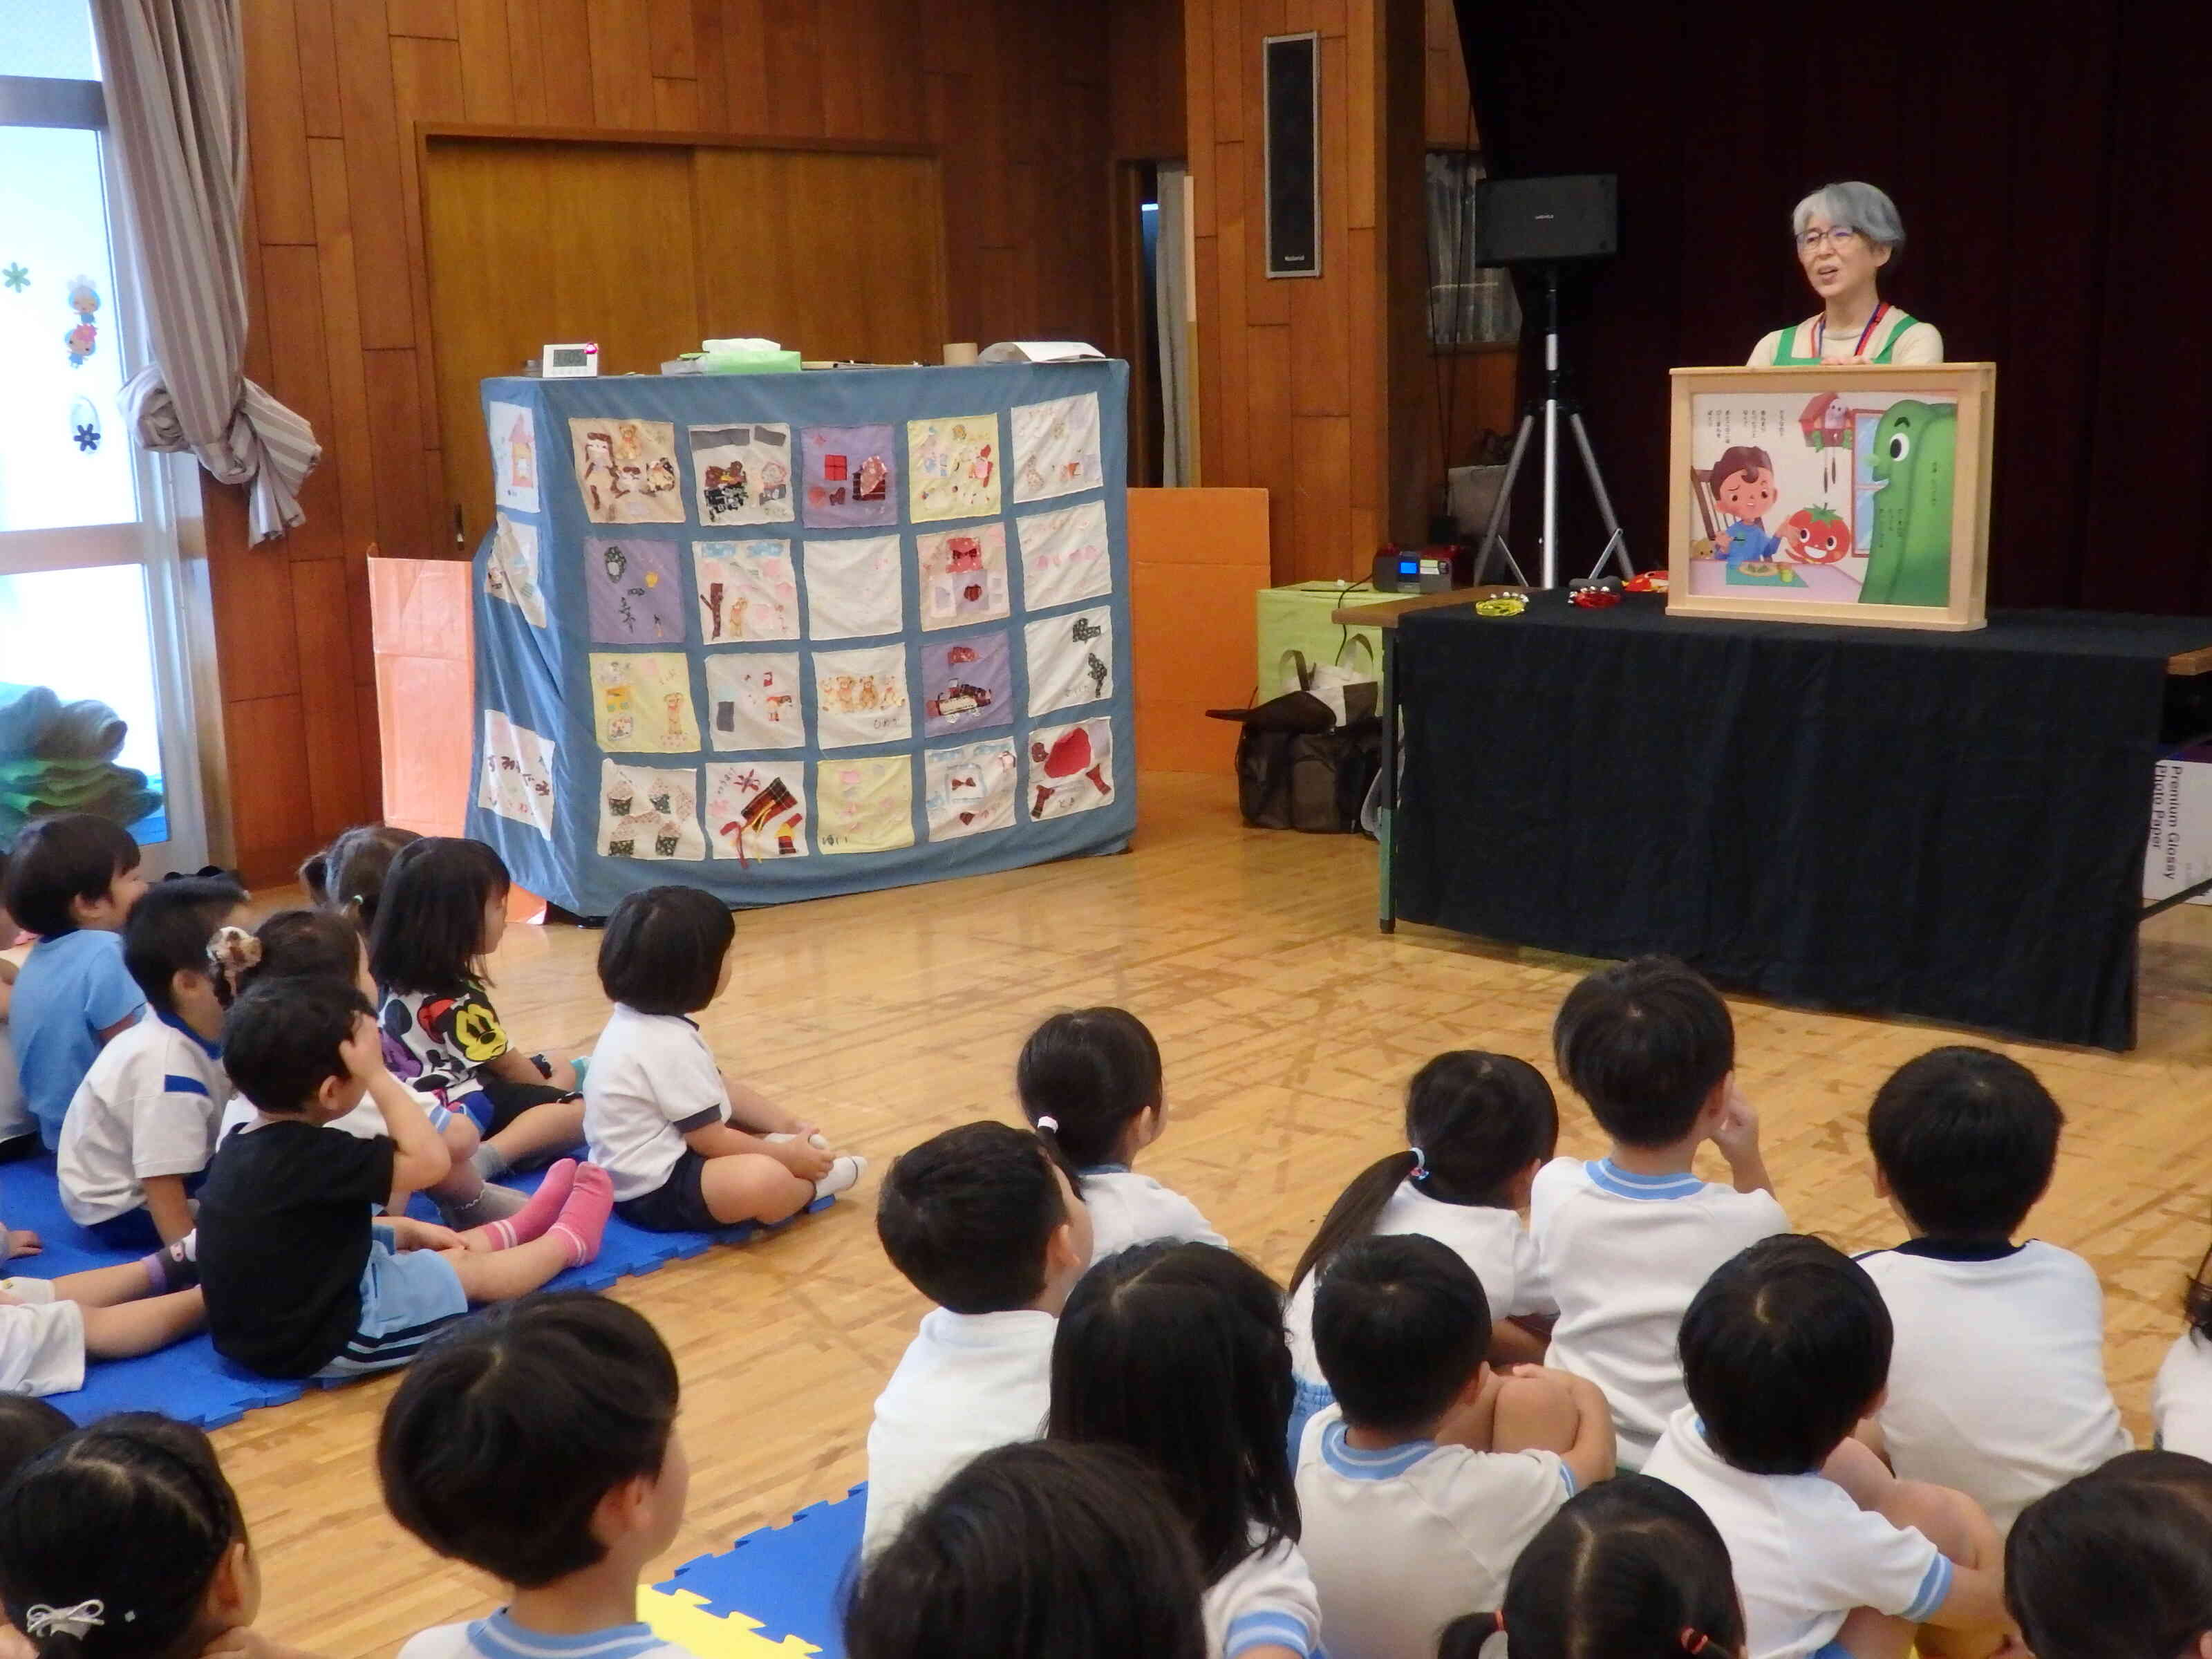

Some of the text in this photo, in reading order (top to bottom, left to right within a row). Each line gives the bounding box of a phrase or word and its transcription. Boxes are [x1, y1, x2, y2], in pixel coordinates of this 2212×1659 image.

[2150, 765, 2168, 849] Photo Paper
[2168, 766, 2183, 827] Premium
